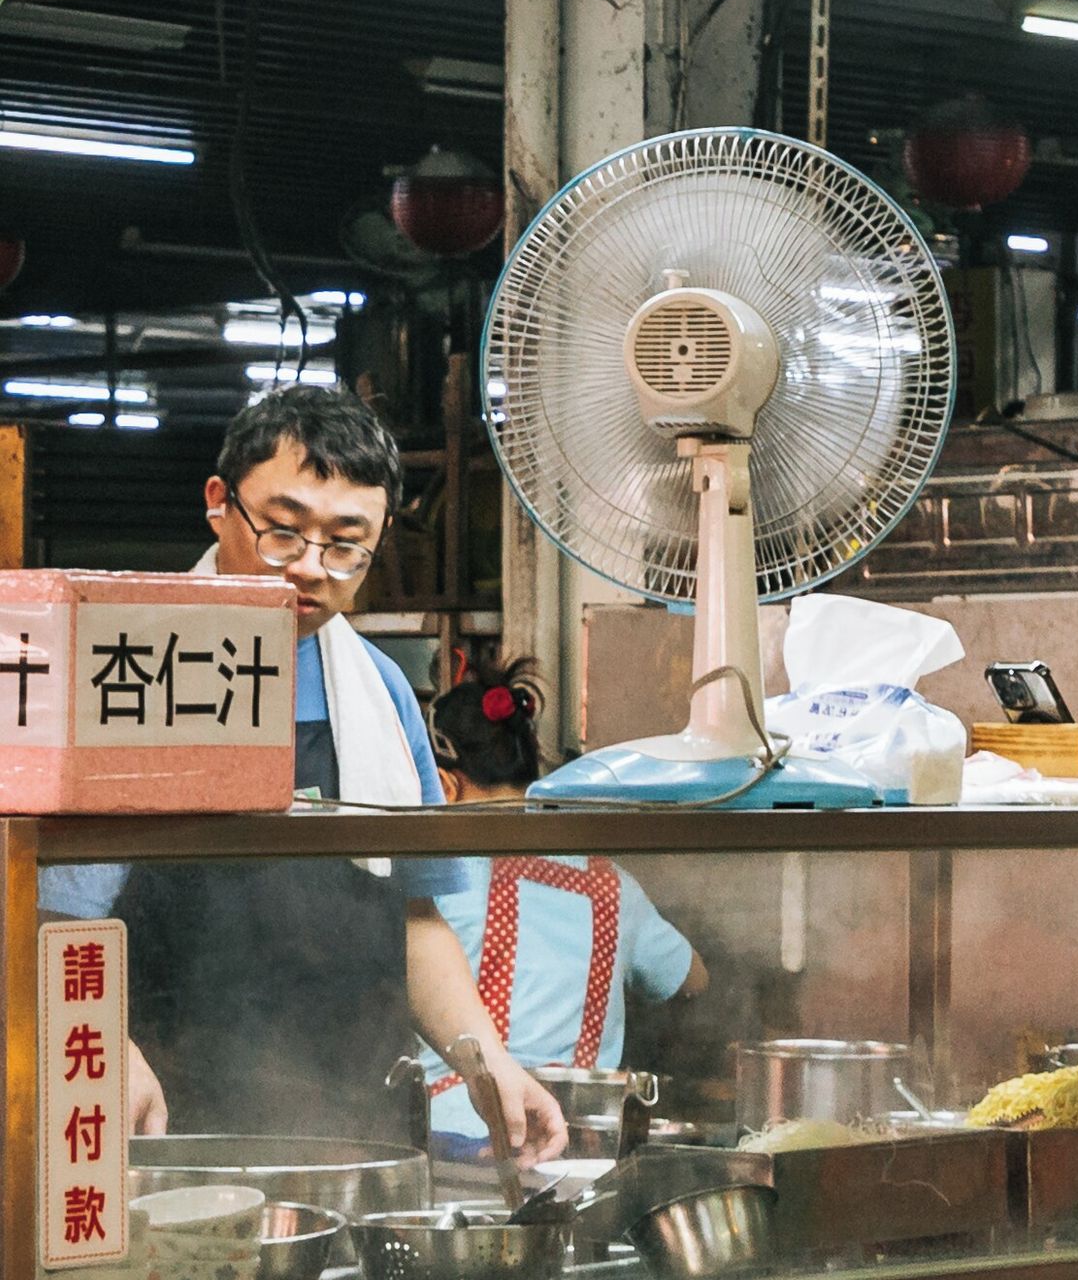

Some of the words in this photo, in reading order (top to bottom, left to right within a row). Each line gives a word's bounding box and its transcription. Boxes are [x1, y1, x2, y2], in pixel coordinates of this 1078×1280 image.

[91, 632, 279, 727] 杏仁汁
[63, 942, 106, 1244] 請先付款
